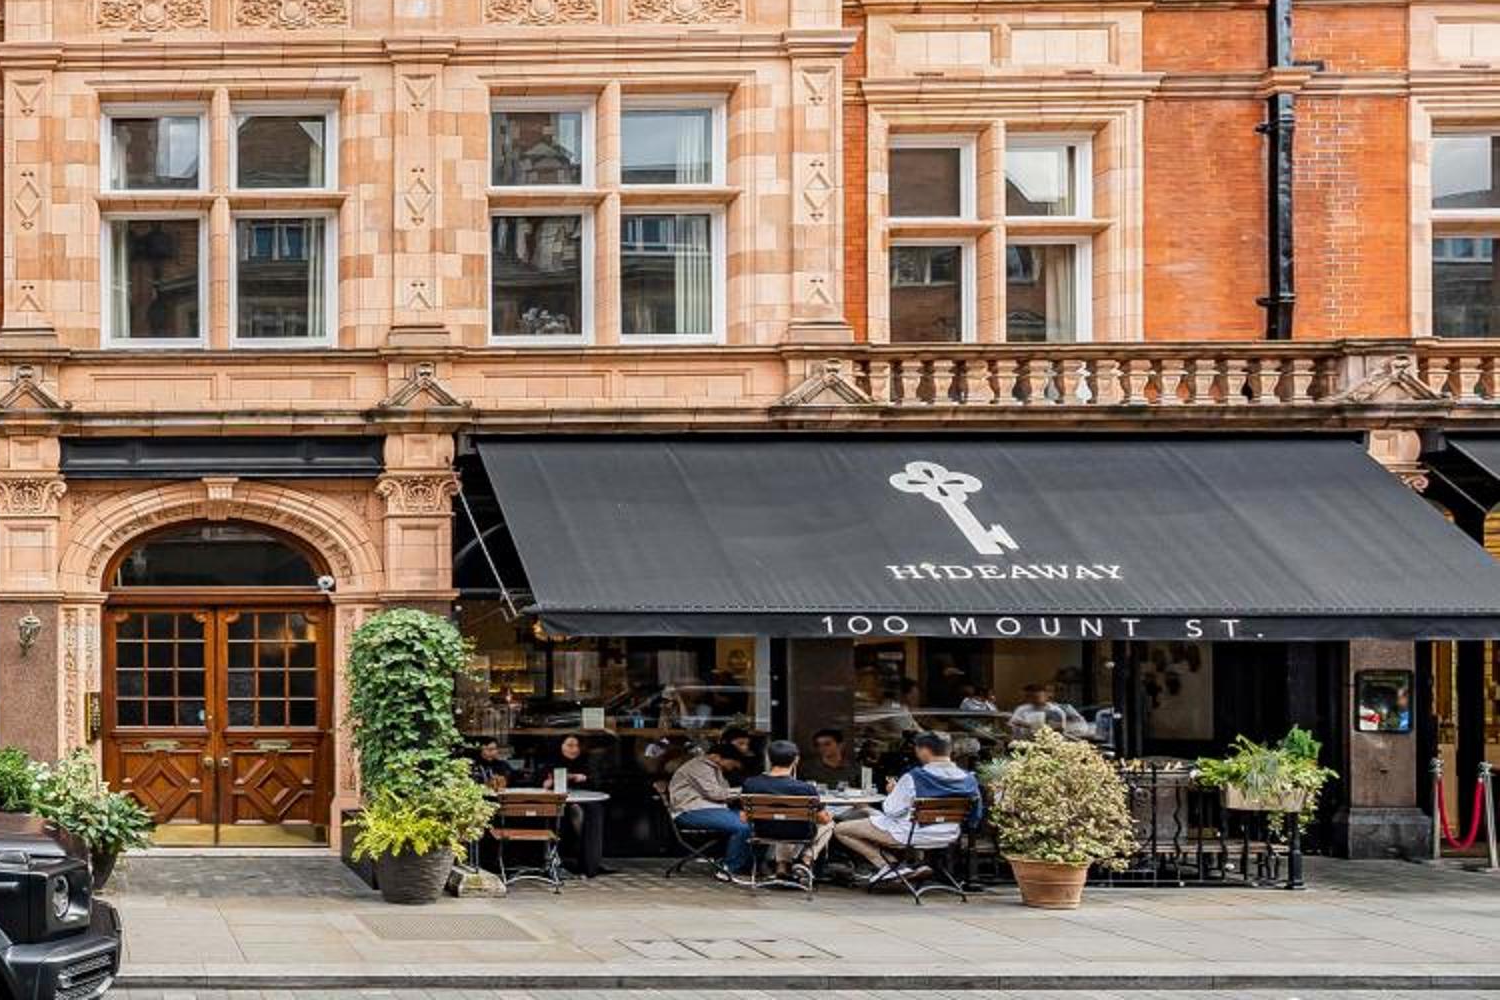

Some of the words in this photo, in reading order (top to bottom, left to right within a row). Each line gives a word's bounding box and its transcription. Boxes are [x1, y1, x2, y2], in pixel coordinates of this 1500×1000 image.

[821, 614, 909, 635] 100
[949, 616, 1141, 637] MOUNT
[1185, 618, 1265, 638] ST.
